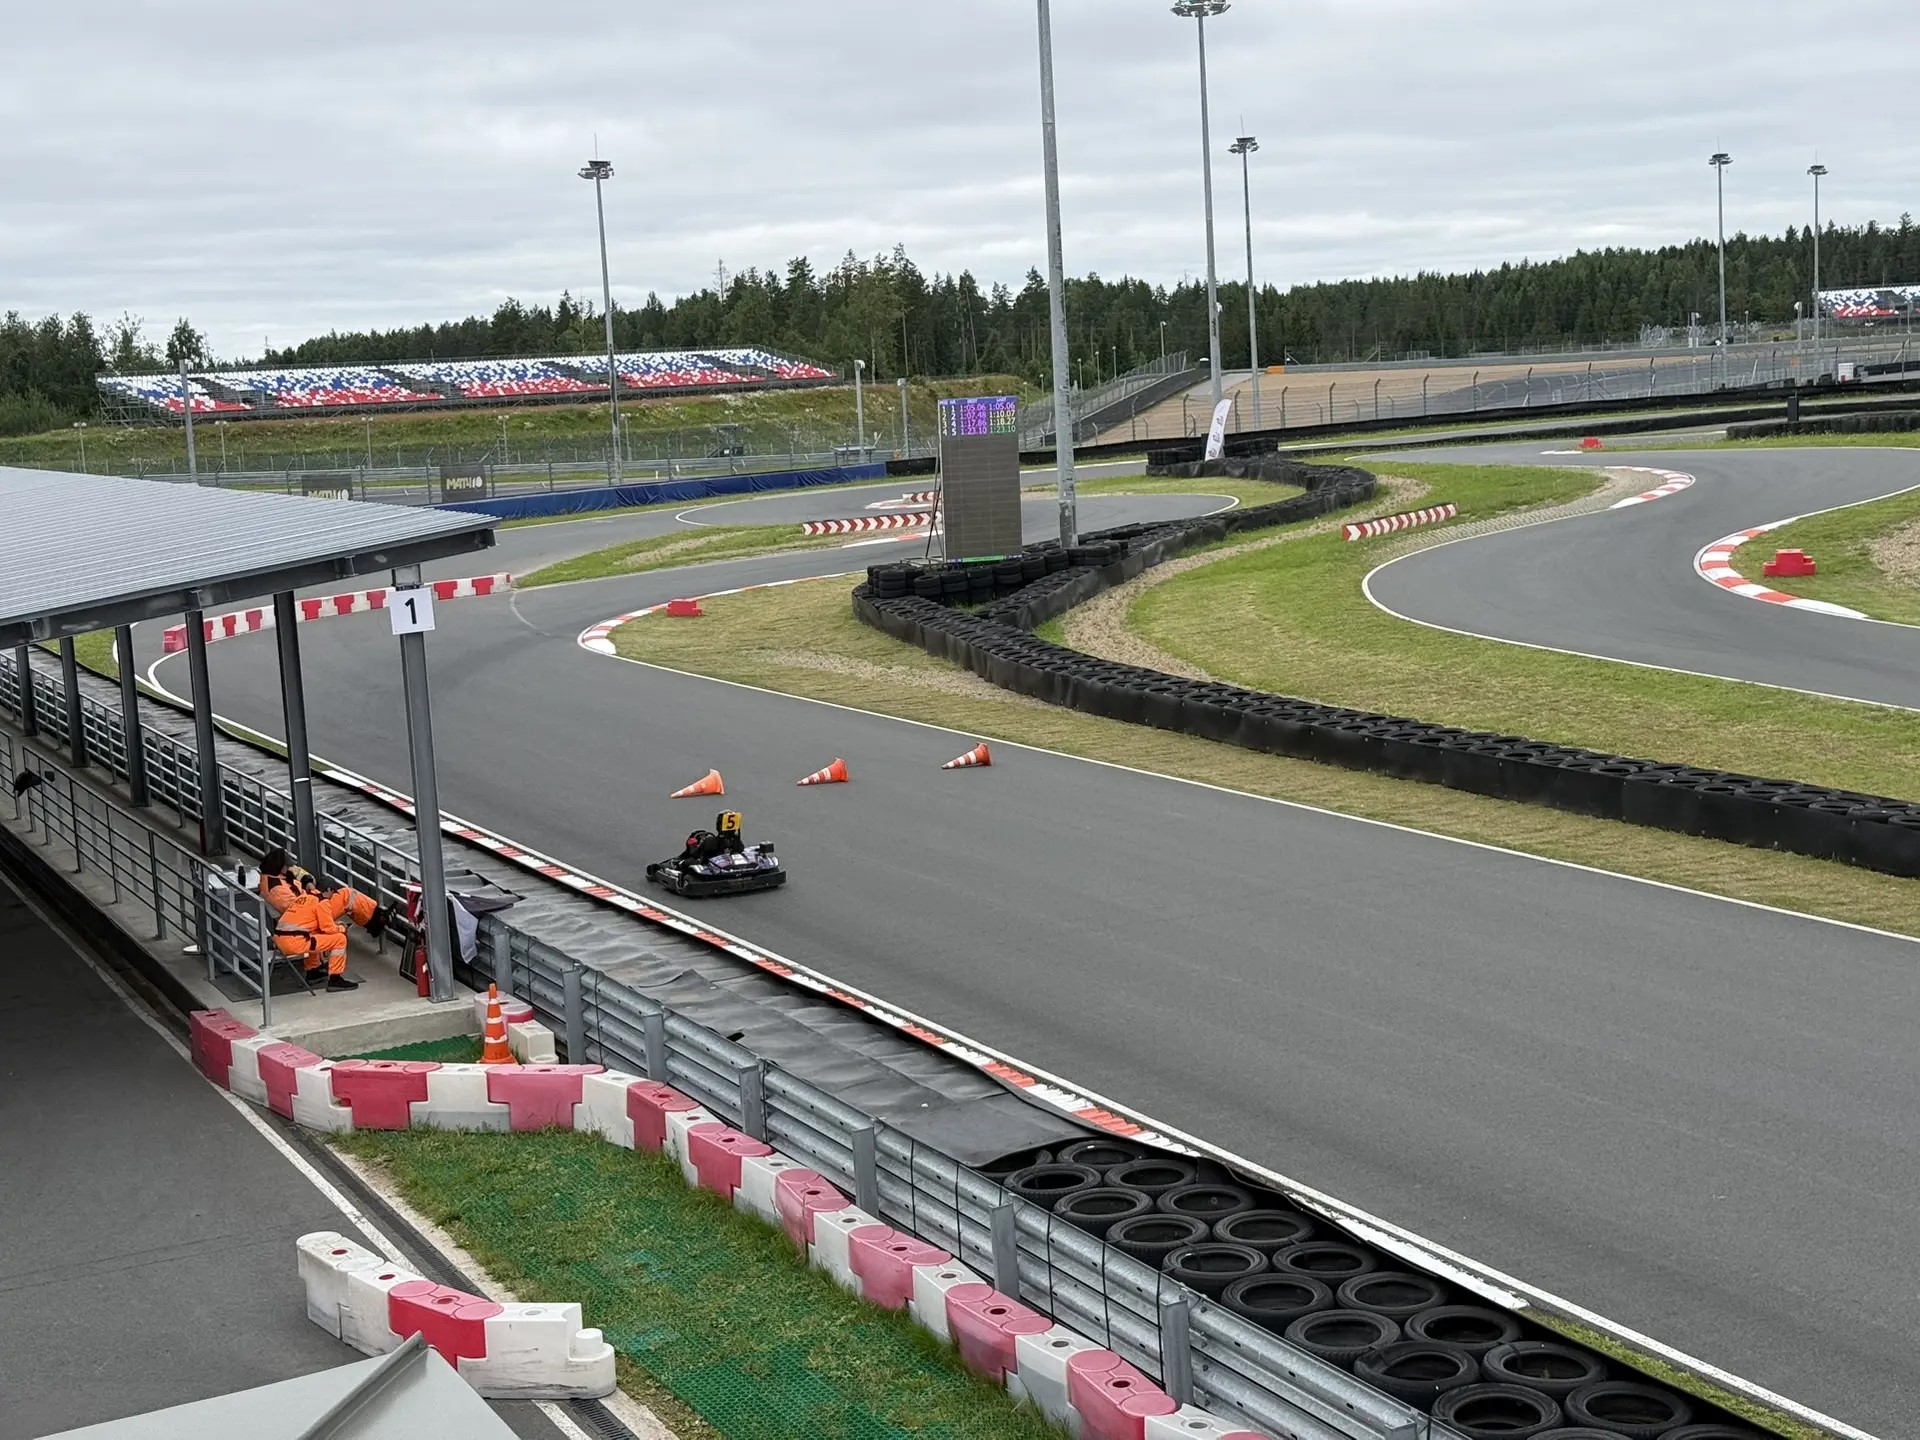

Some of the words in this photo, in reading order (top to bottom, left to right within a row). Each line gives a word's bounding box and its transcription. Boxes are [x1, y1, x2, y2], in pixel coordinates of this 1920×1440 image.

[960, 404, 986, 412] 1:05.06
[989, 402, 1016, 410] 1:05.06
[989, 410, 1015, 418] 1:10.07
[961, 427, 987, 436] 1:23.10
[990, 425, 1016, 434] 1:23.10
[405, 598, 417, 624] 1
[726, 815, 735, 829] 5
